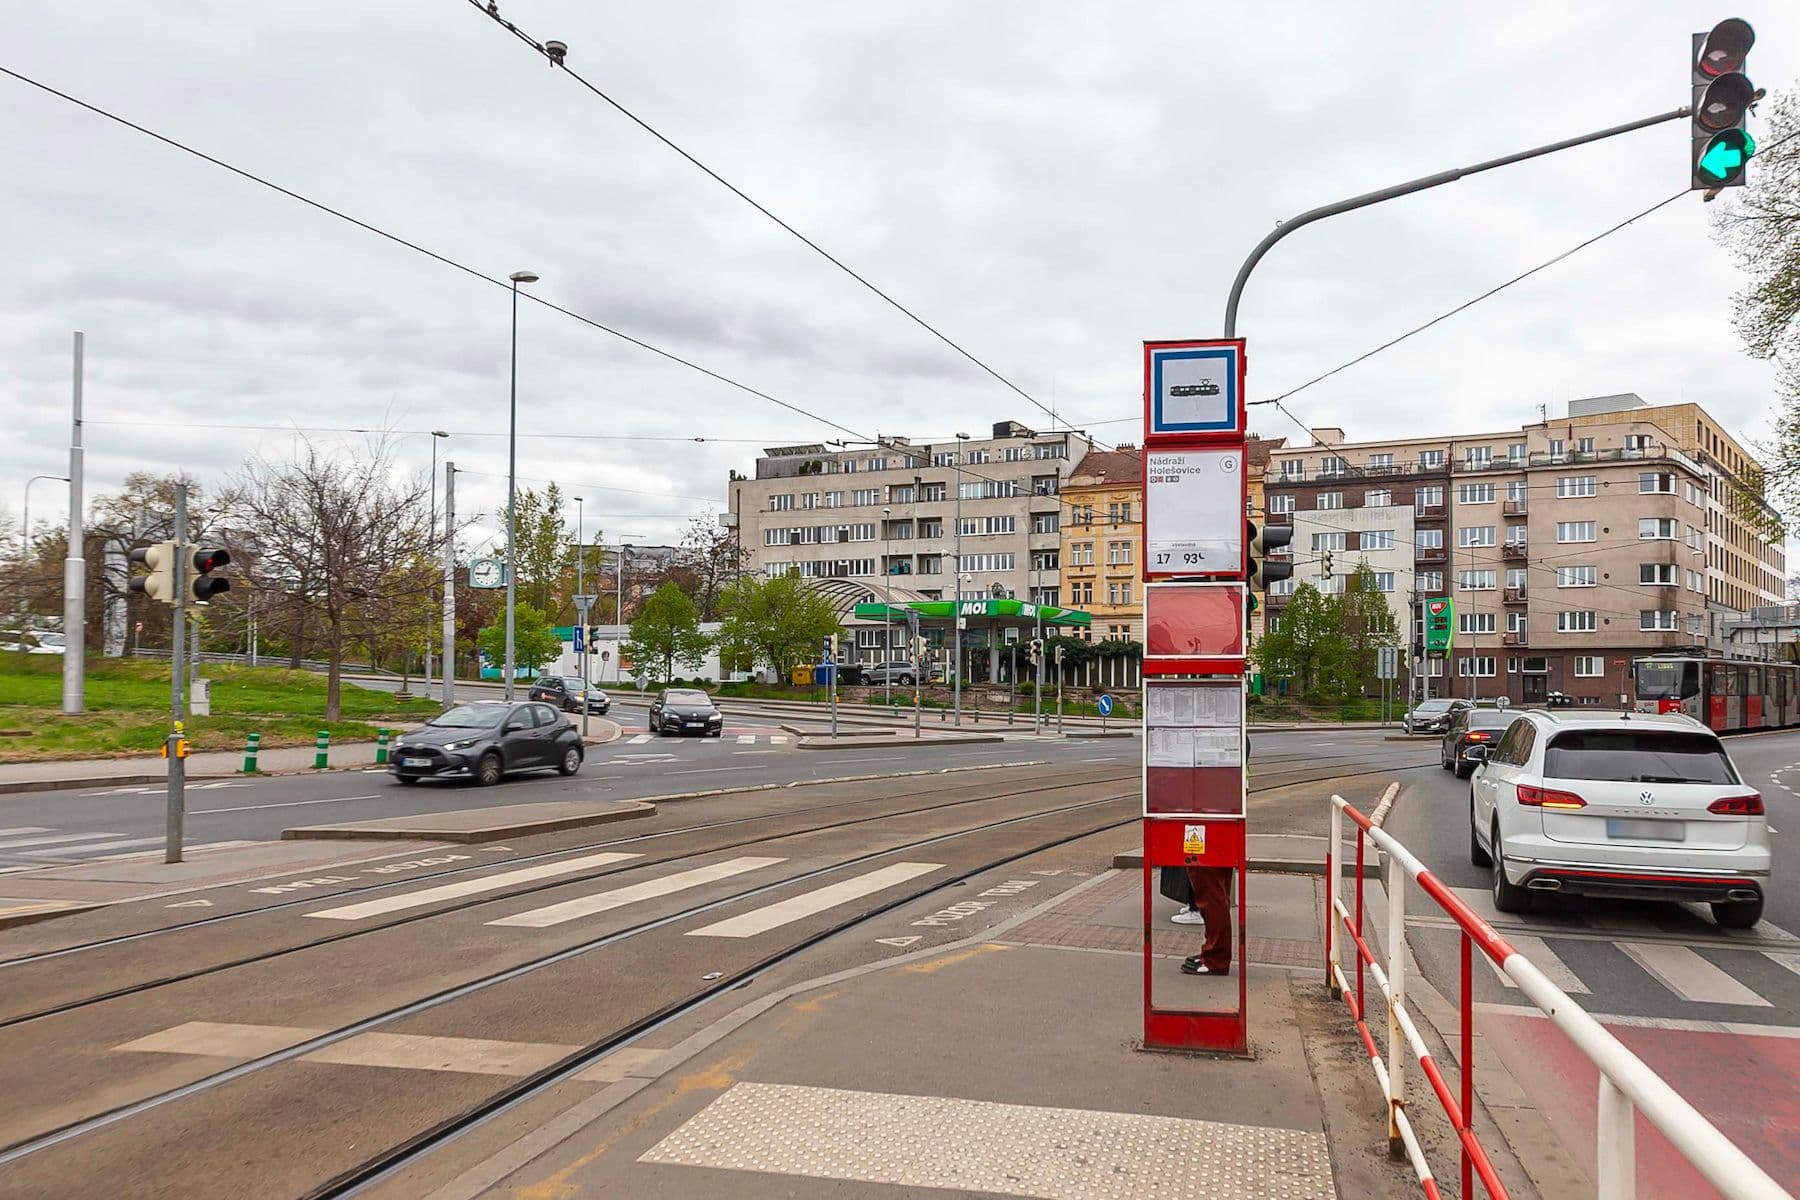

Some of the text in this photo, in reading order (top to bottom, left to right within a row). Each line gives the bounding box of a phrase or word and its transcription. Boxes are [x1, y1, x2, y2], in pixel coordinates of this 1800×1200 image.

[1149, 456, 1185, 466] Nádraží
[1224, 460, 1233, 469] G
[1149, 466, 1201, 475] Holešovice
[1156, 553, 1198, 565] 17 93
[960, 602, 987, 615] MOL
[359, 854, 473, 875] POZOR
[977, 880, 1040, 897] TRAM
[910, 901, 998, 926] POZOR
